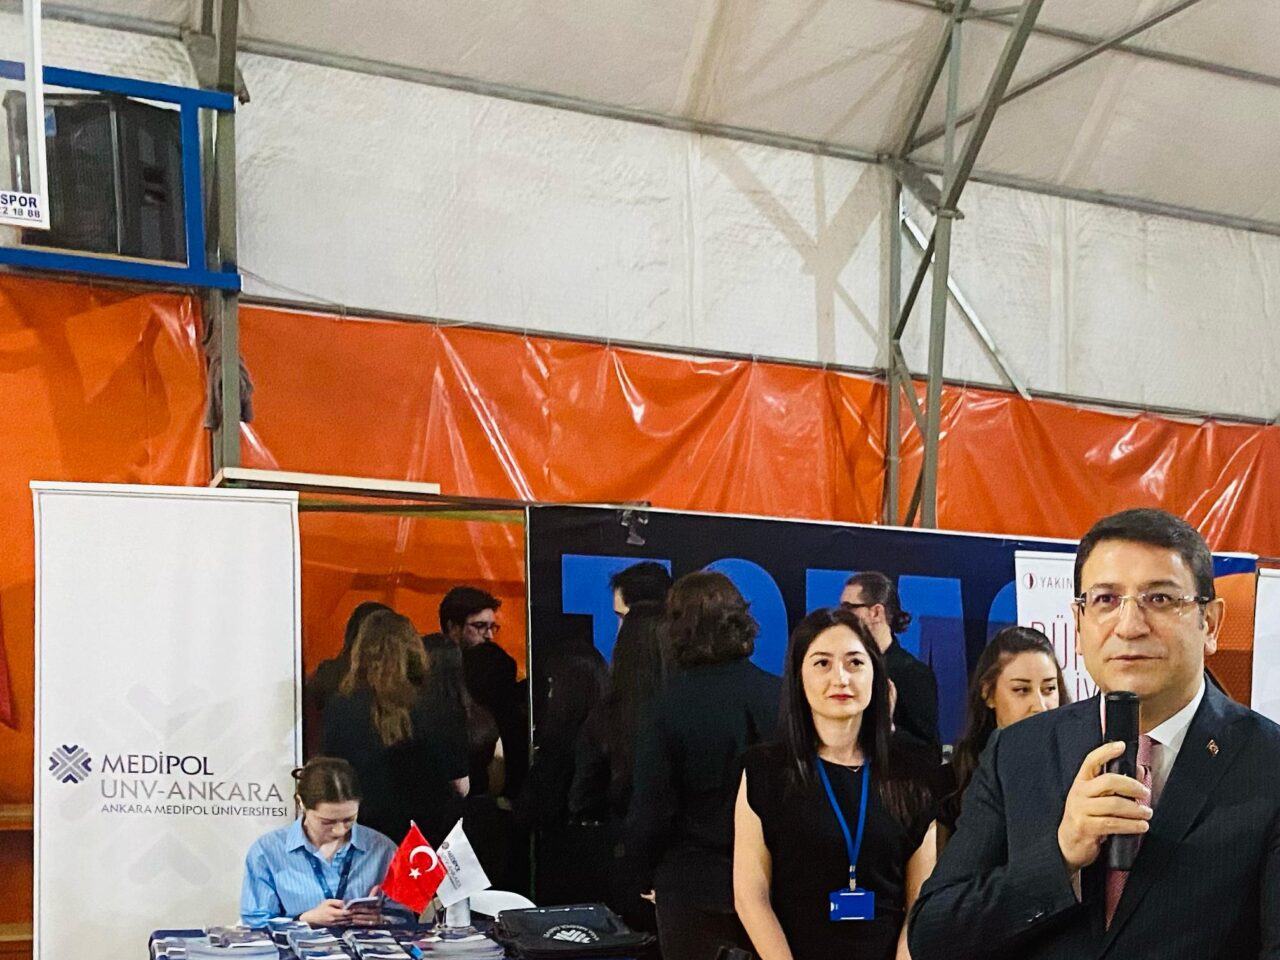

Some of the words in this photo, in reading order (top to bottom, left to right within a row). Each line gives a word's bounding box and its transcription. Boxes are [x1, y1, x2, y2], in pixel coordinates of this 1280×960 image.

[0, 193, 37, 208] SPOR
[0, 206, 8, 215] 2
[1040, 576, 1073, 590] YAKIN
[101, 751, 214, 776] MEDİPOL
[101, 779, 284, 802] UNV-ANKARA
[101, 803, 152, 814] ANKARA
[154, 804, 209, 815] MEDİPOL
[211, 803, 288, 817] ÜNİVERSİTESİ
